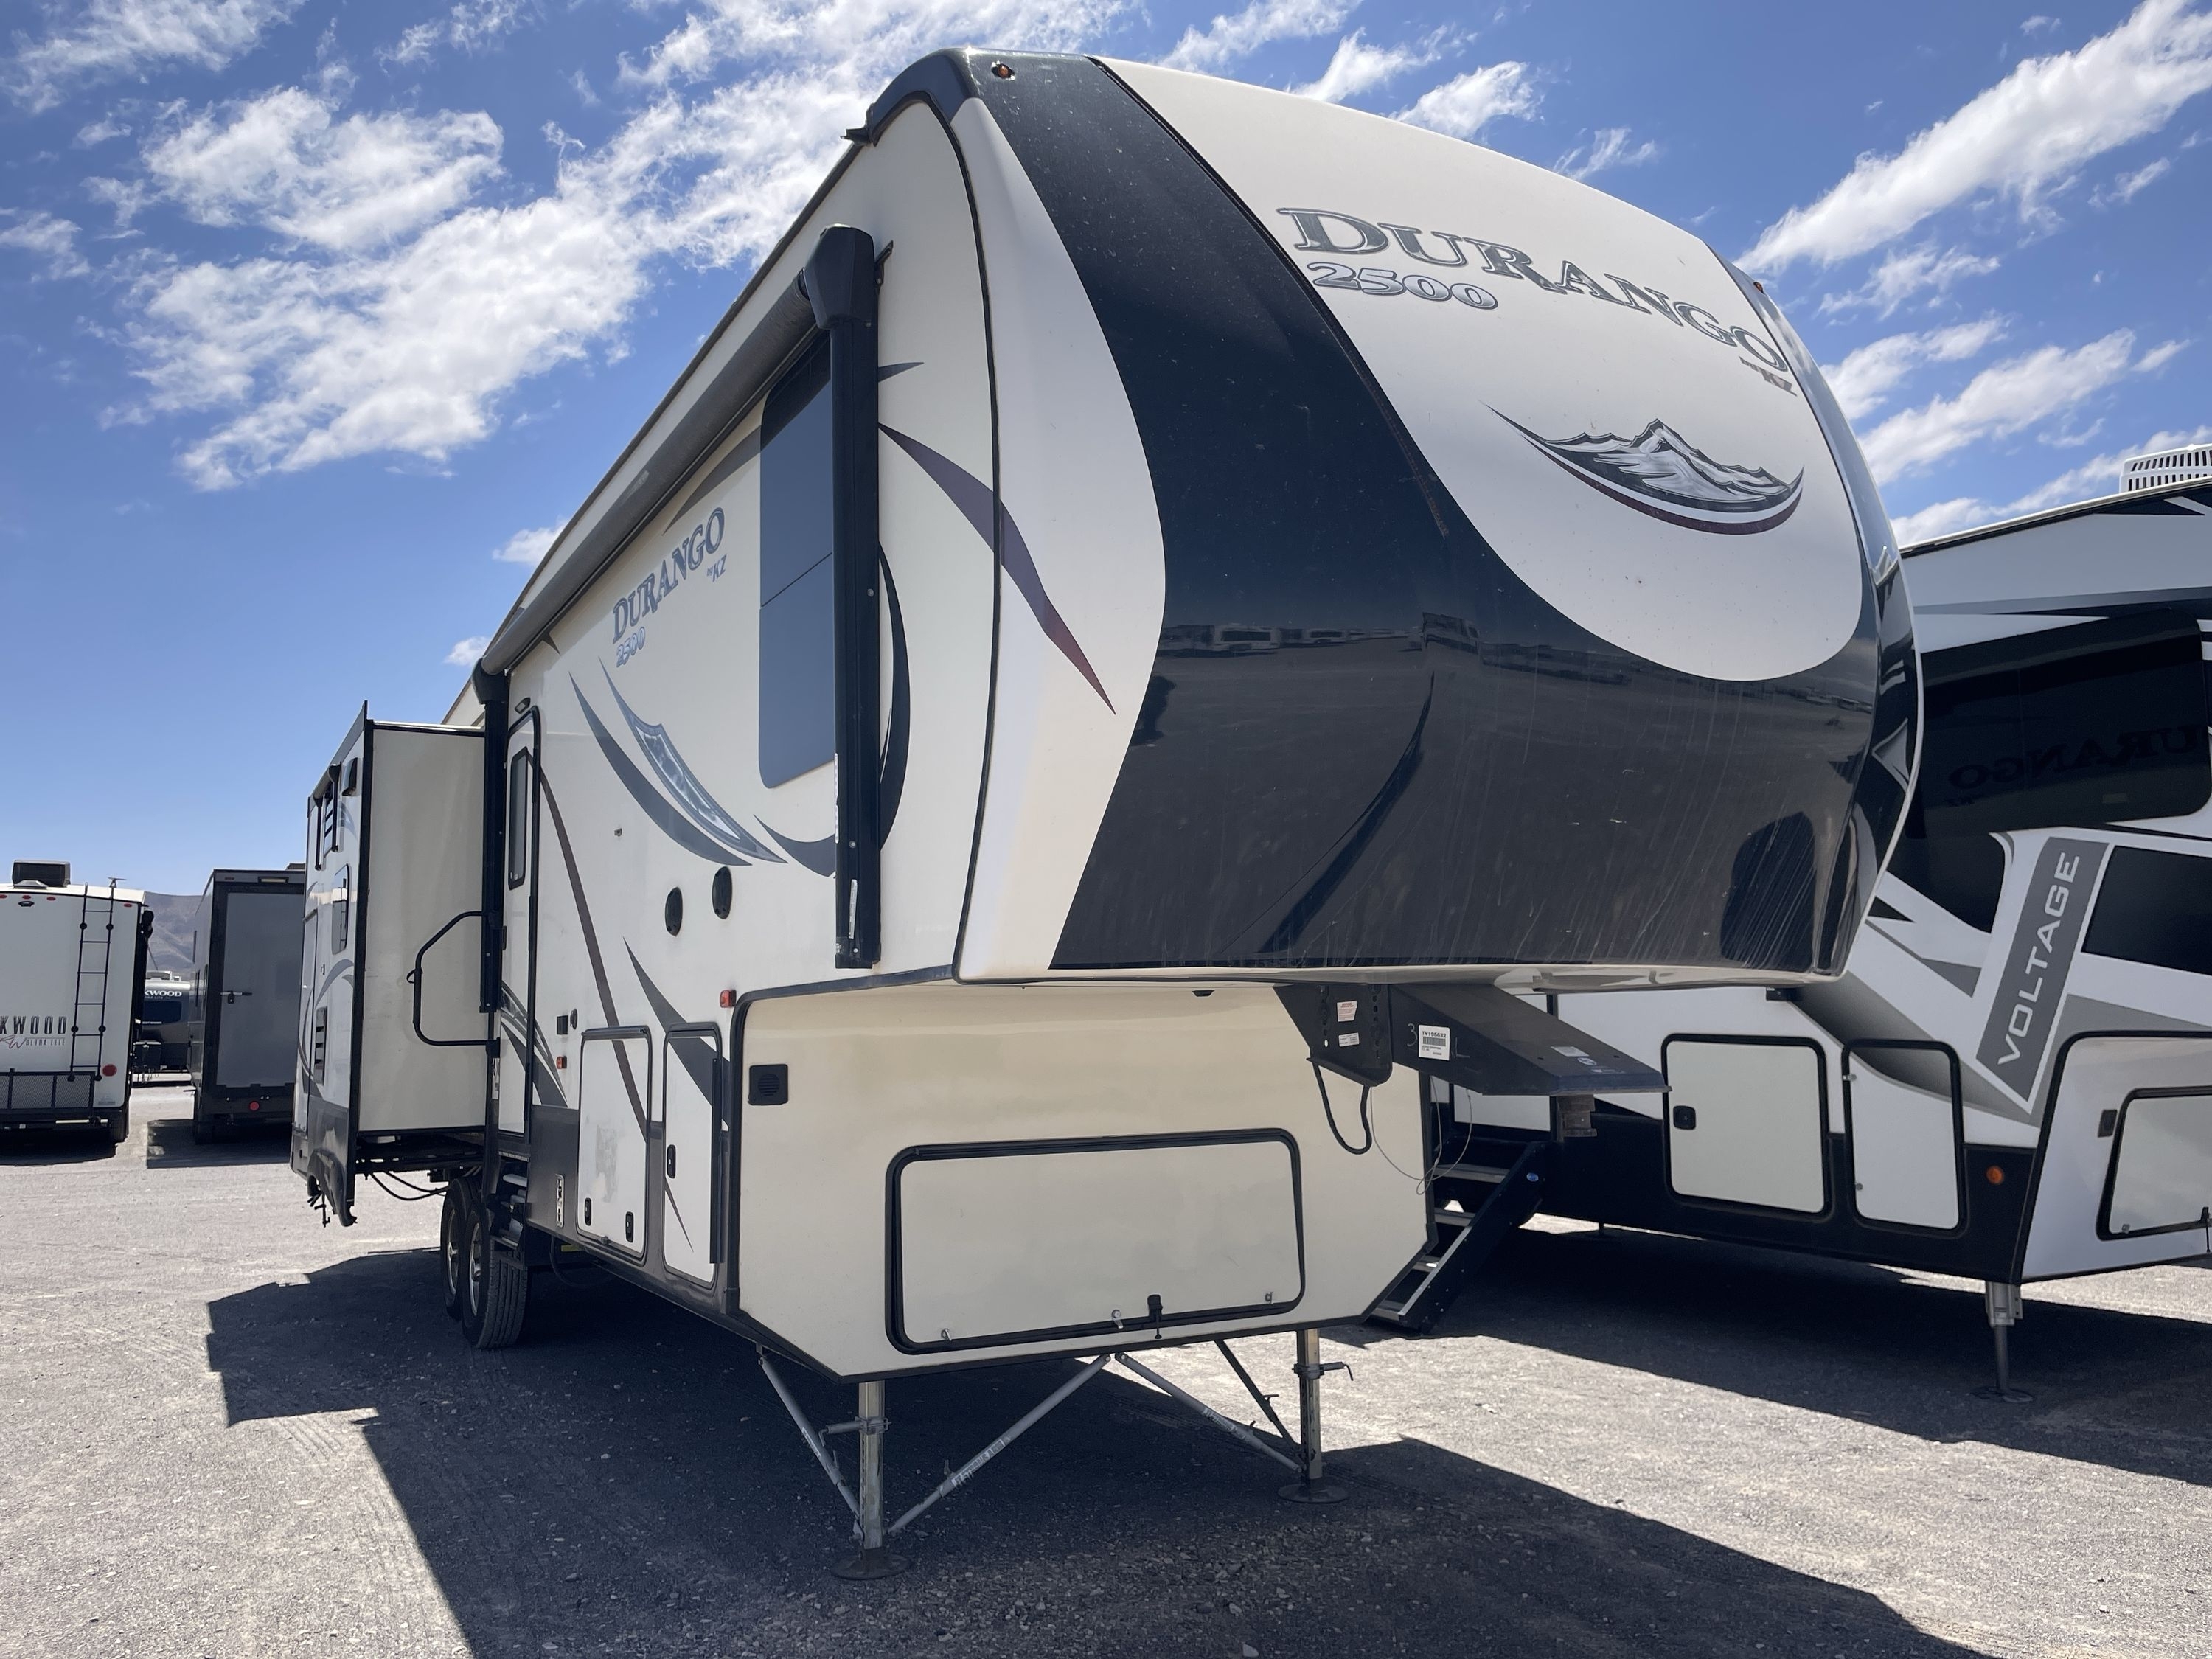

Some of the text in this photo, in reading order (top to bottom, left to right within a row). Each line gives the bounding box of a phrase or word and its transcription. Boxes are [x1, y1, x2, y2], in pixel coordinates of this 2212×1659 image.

[1276, 207, 1789, 372] DURANGO
[1307, 262, 1498, 310] 2500
[613, 507, 725, 644] DURANGO
[713, 554, 727, 582] KZ
[616, 627, 645, 667] 2500
[1997, 851, 2079, 1065] VOLTAGE
[0, 1016, 67, 1034] KWOOD
